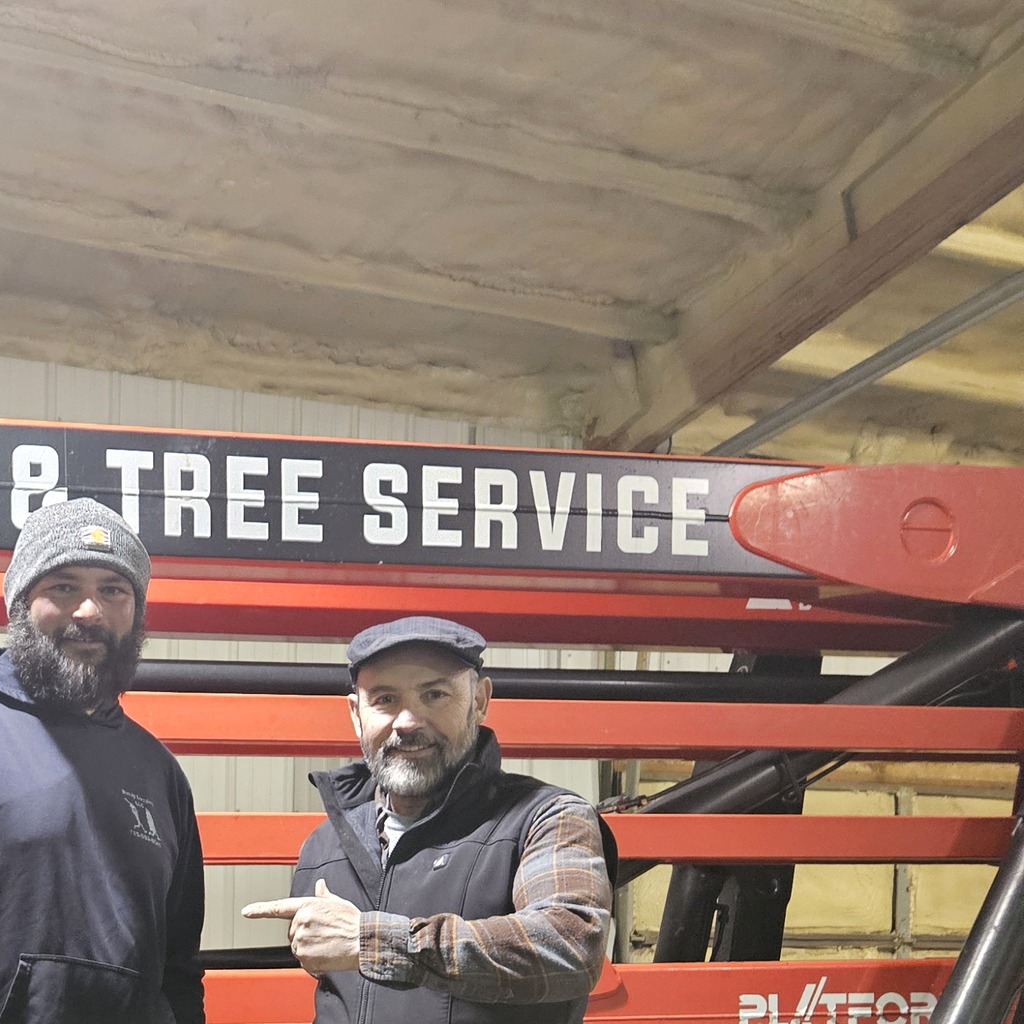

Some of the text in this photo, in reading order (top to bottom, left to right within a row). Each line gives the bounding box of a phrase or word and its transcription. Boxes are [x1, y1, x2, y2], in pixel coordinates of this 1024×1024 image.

[11, 444, 69, 531] &
[106, 448, 323, 542] TREE
[363, 462, 710, 556] SERVICE
